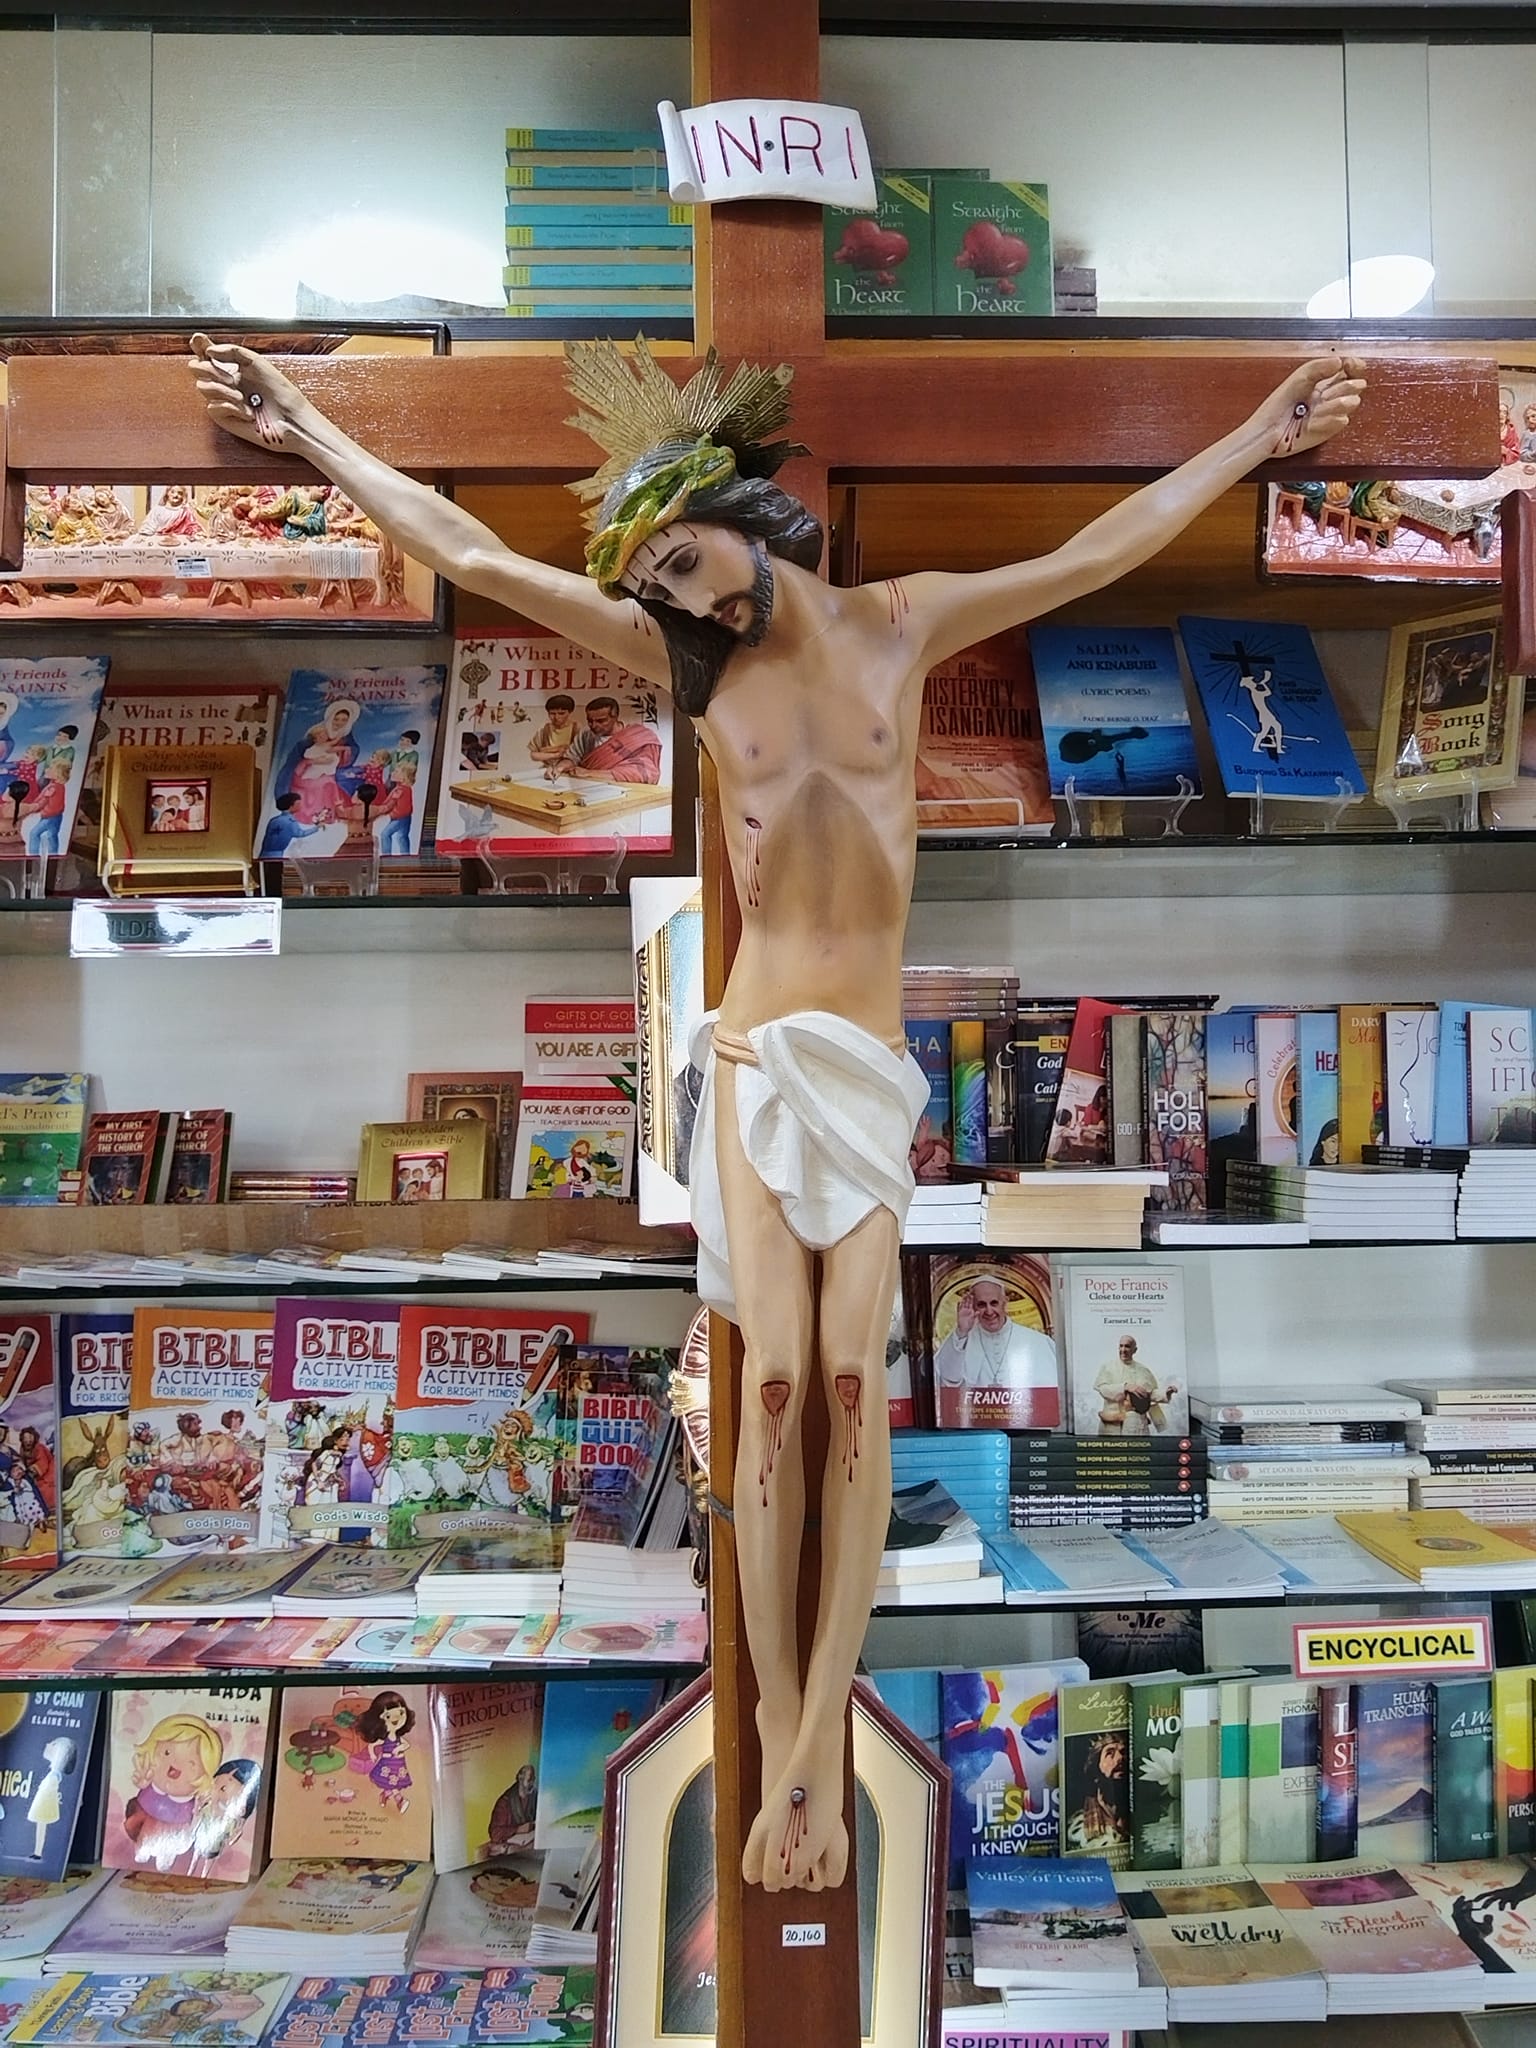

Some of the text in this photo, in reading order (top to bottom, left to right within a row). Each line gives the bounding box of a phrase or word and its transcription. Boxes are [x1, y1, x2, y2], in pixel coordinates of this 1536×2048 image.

[504, 646, 560, 661] What
[567, 646, 584, 661] is
[957, 662, 976, 677] ANG
[1067, 660, 1093, 670] ANG
[8, 668, 67, 681] Friends
[7, 682, 67, 693] SAINTS
[328, 676, 405, 690] My Friends
[348, 690, 406, 701] SAINTS
[123, 703, 229, 719] What is the
[1416, 710, 1486, 737] Song
[1418, 734, 1481, 755] Book
[555, 1010, 588, 1021] GIFTS
[591, 1010, 606, 1021] OF
[588, 1022, 602, 1030] and
[536, 1042, 638, 1057] YOU ARE A GIFT
[1036, 1056, 1064, 1069] God
[23, 1108, 72, 1121] Prayer
[523, 1105, 630, 1115] YOU ARE A GIFT OF GOD
[106, 1120, 143, 1130] MY FIRST
[1157, 1112, 1202, 1132] FOR
[99, 1132, 145, 1142] HISTORY OF
[195, 1131, 208, 1141] OF
[97, 1142, 143, 1153] THE CHURCH
[1085, 1278, 1168, 1294] Pope Francis
[1088, 1293, 1112, 1301] Close
[1113, 1293, 1120, 1301] to
[1137, 1293, 1164, 1301] Hearts
[301, 1323, 399, 1362] BIBL
[158, 1331, 274, 1371] BIBLE
[425, 1330, 543, 1371] BIBLE
[300, 1361, 399, 1379] ACTIVITIES
[157, 1371, 260, 1387] ACTIVITIES
[298, 1377, 396, 1391] FOR BRIGHT MINDS
[76, 1393, 96, 1402] FOR
[156, 1387, 254, 1398] FOR BRIGHT MINDS
[963, 1390, 1023, 1406] FRANCIS
[1297, 1408, 1327, 1417] ALWAYS
[1328, 1407, 1349, 1417] OPEN
[1304, 1465, 1334, 1474] ALWAYS
[1335, 1464, 1356, 1473] OPEN
[352, 1510, 389, 1522] Wisdo
[224, 1518, 250, 1529] Plan
[1117, 1611, 1166, 1634] to Me
[1308, 1634, 1475, 1661] ENCYCLICAL
[53, 1692, 85, 1708] CHAN
[1282, 1703, 1319, 1715] THOMA
[31, 1715, 63, 1727] ELAINE
[1451, 1711, 1466, 1730] A
[983, 1779, 1006, 1790] THE
[990, 1823, 1060, 1839] THOUGH
[981, 1840, 1028, 1855] KNEW
[976, 1871, 1104, 1884] Valley of Tears
[1288, 1872, 1333, 1880] THOMAS
[1340, 1910, 1406, 1928] Friend
[1171, 1920, 1284, 1944] well dry
[1328, 1921, 1425, 1937] Bridegroom
[85, 1975, 149, 2017] Bible
